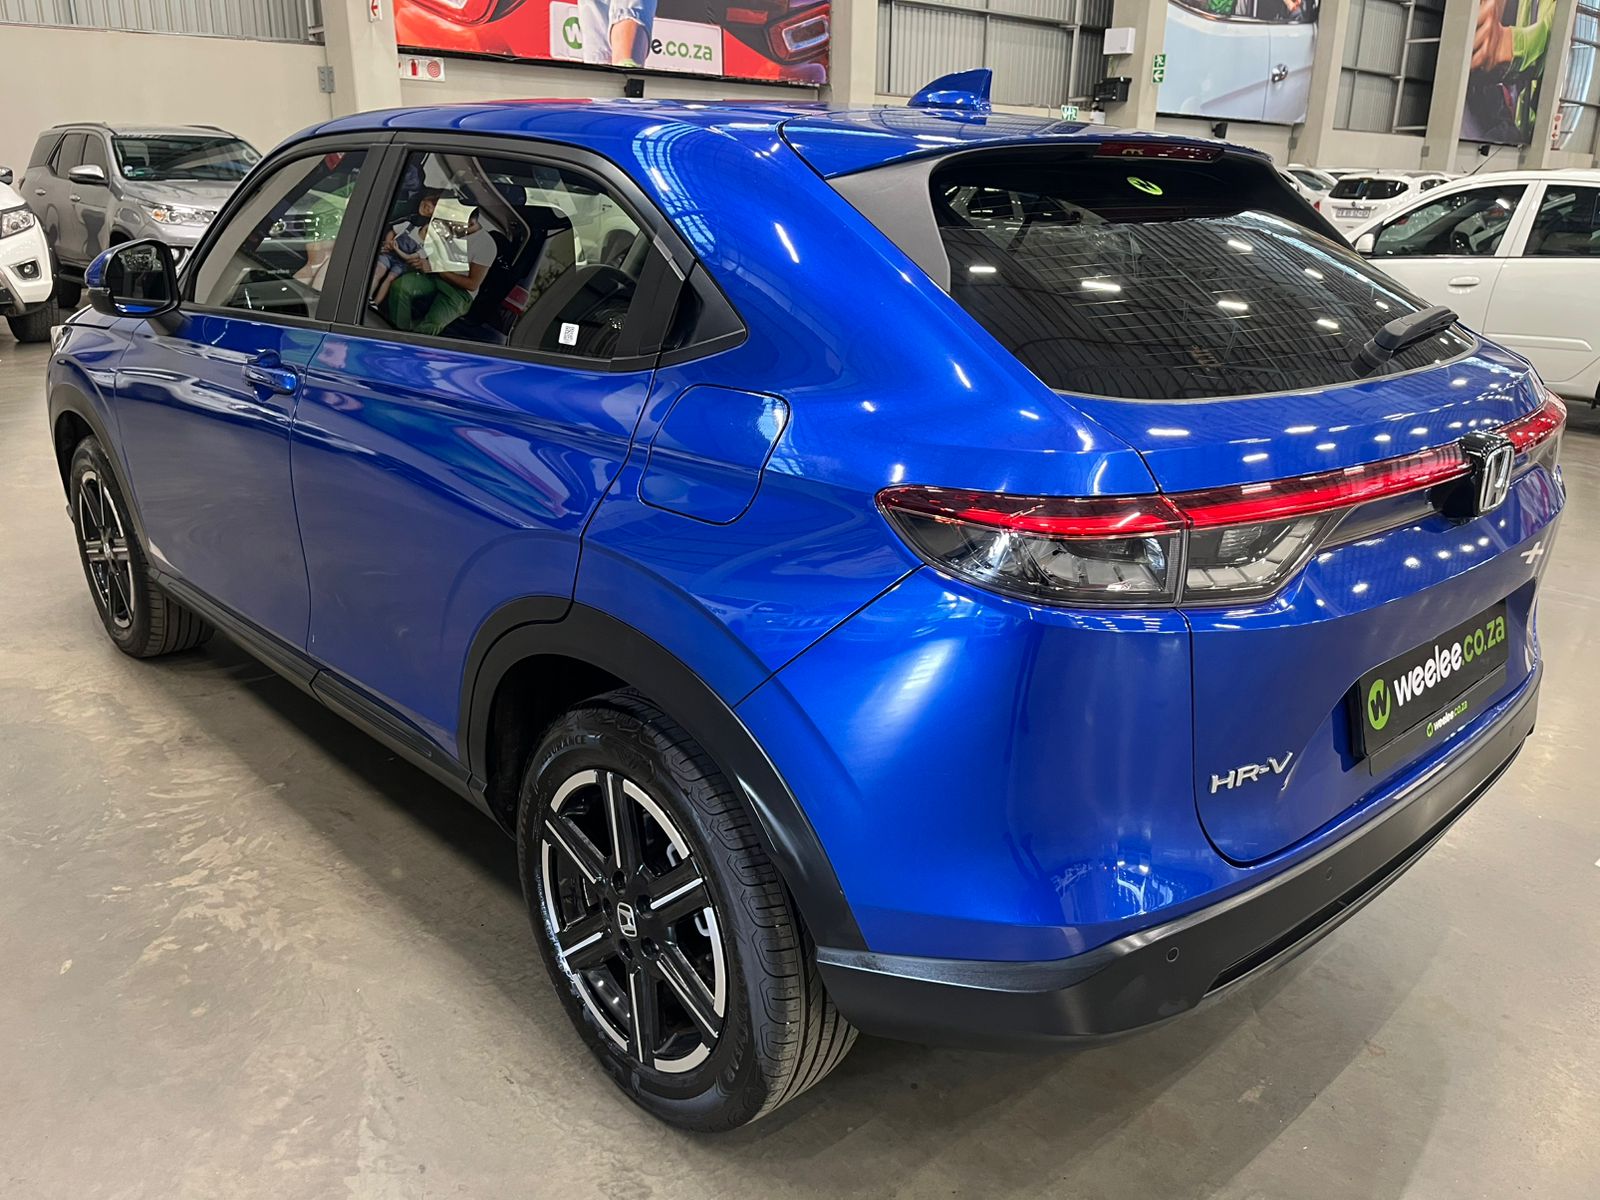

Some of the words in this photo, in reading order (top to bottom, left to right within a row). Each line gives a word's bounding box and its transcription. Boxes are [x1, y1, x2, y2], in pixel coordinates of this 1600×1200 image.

[650, 38, 713, 61] e.co.za
[1393, 615, 1505, 707] weelee.co.za
[1210, 750, 1293, 794] HR-V
